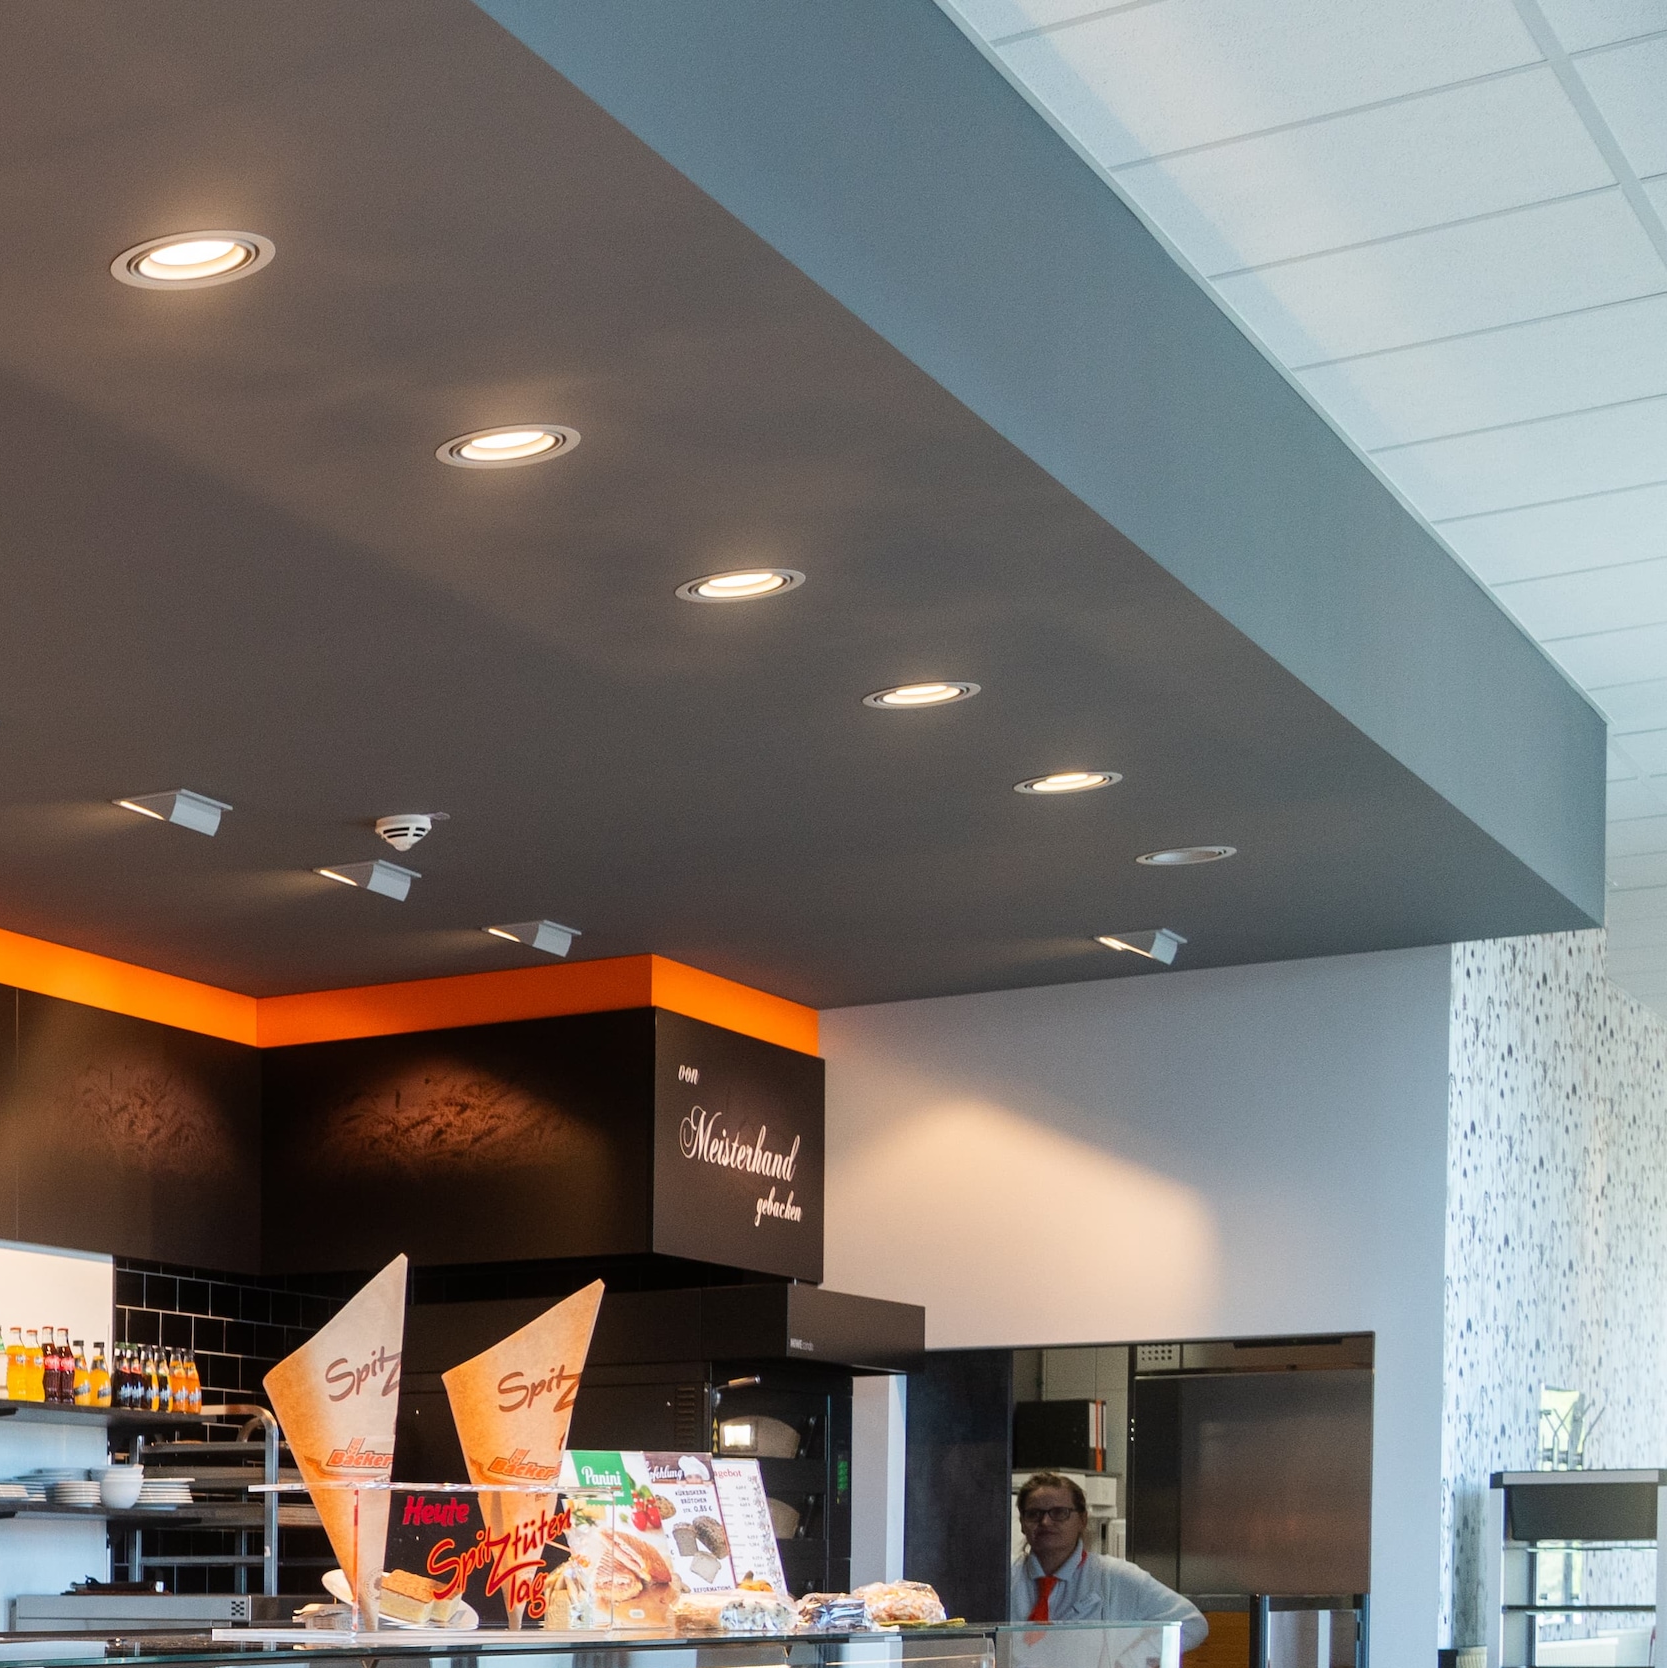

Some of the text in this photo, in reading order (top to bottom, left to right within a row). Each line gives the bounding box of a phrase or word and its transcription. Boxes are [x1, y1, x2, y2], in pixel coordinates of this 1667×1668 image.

[678, 1064, 699, 1085] von
[679, 1105, 800, 1182] Meisterhand
[755, 1186, 802, 1227] gebacken
[581, 1466, 622, 1486] Panini
[402, 1495, 470, 1526] Heute
[694, 1505, 708, 1513] 0,85
[501, 1560, 549, 1618] Tag
